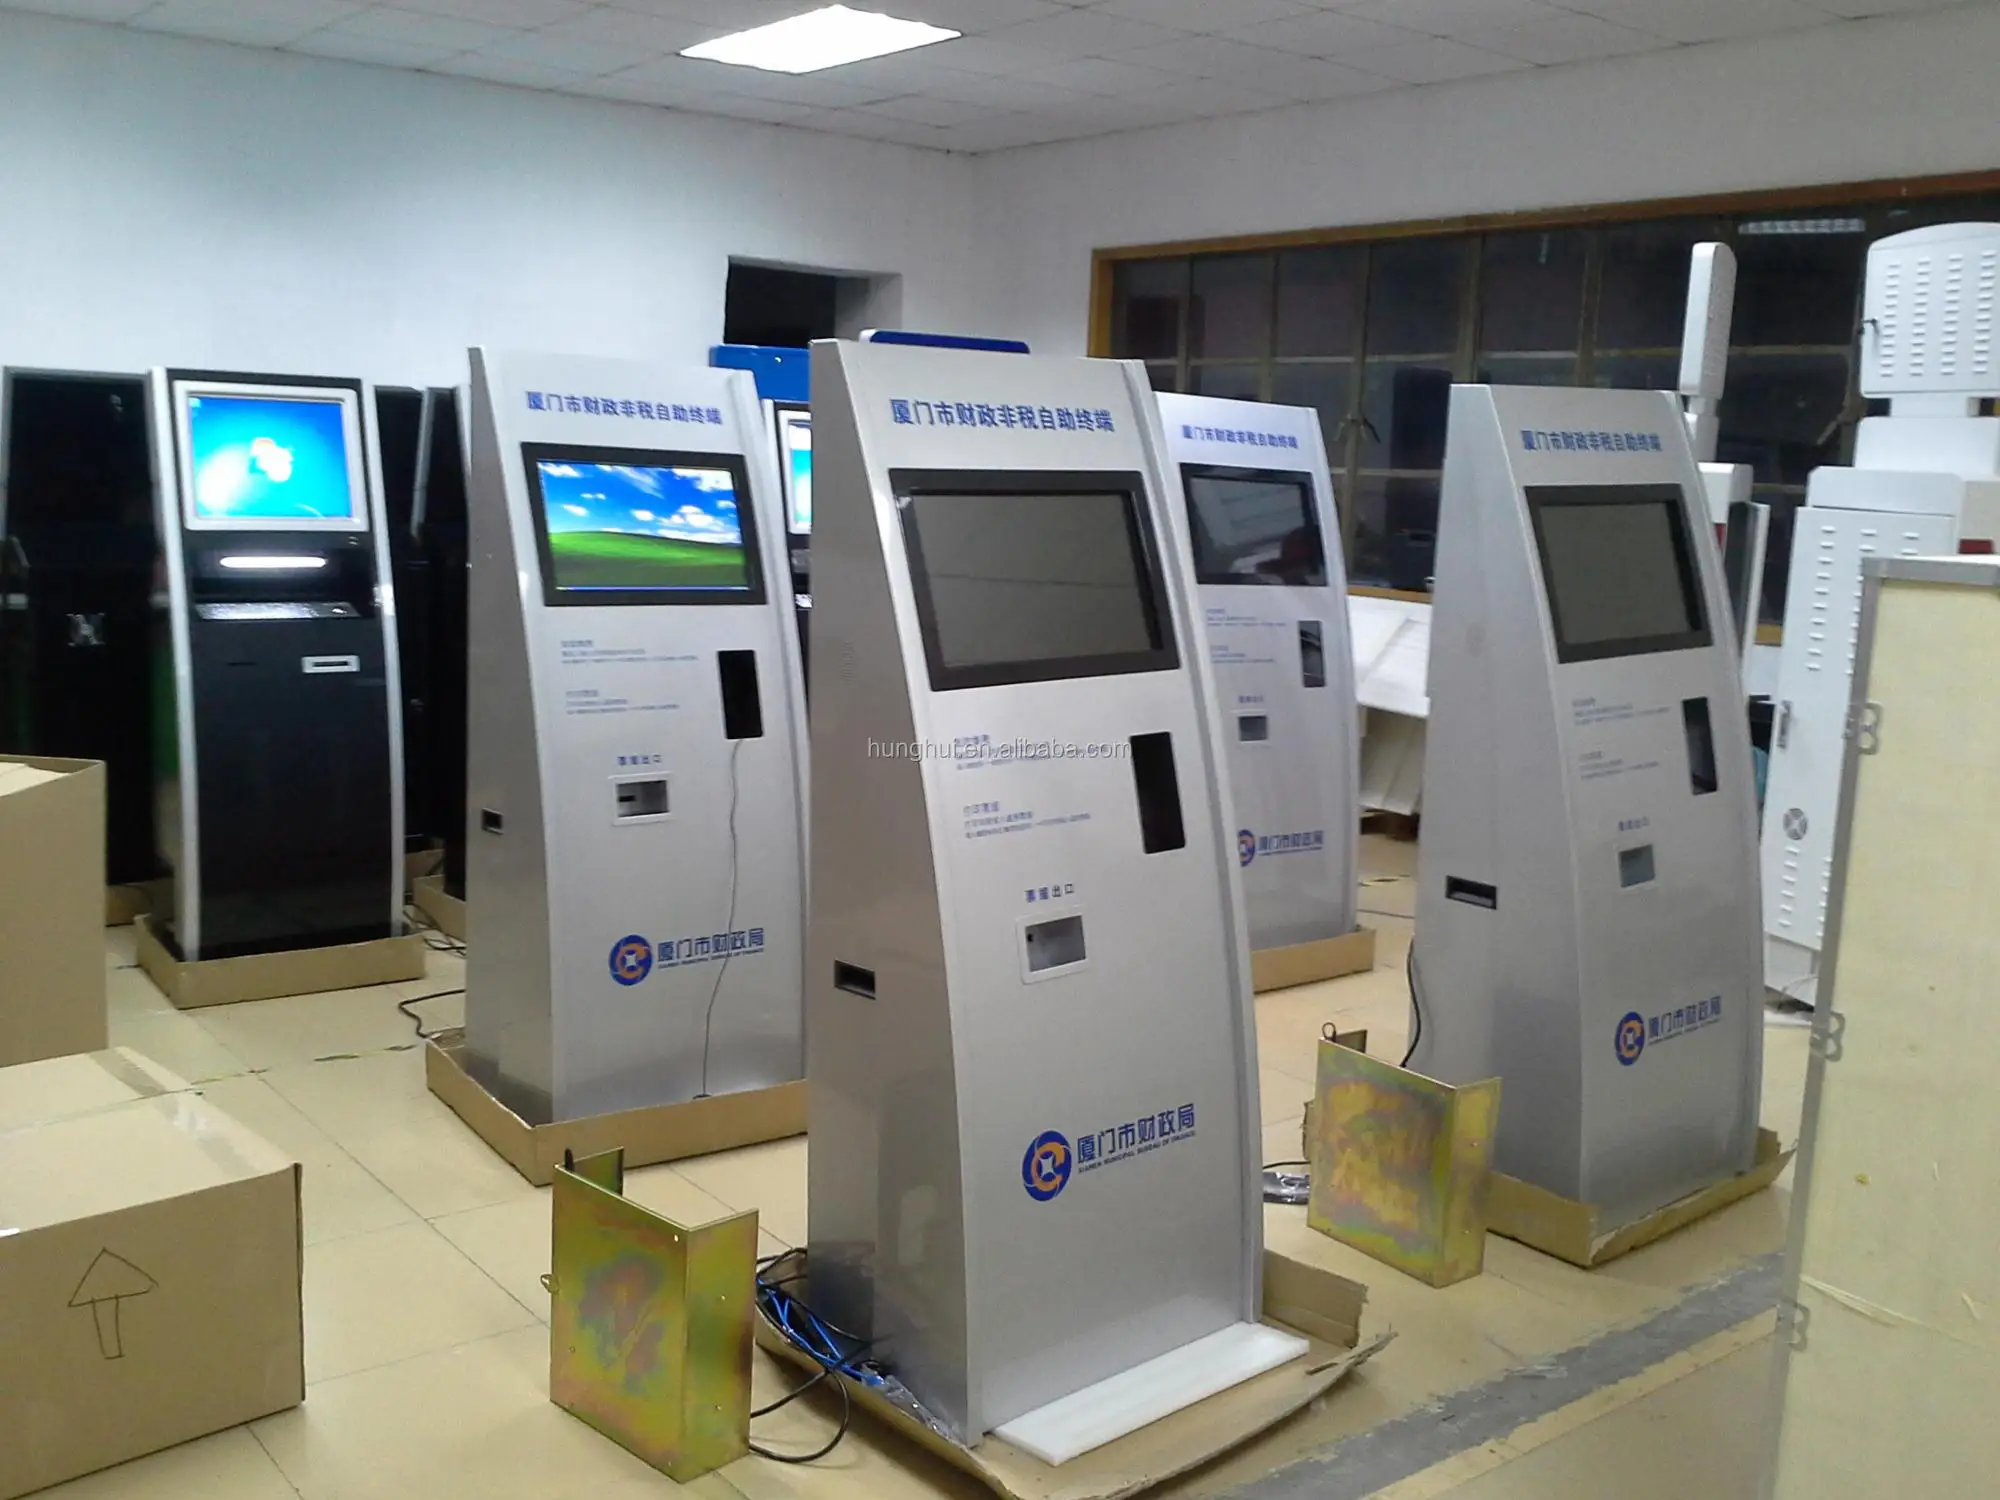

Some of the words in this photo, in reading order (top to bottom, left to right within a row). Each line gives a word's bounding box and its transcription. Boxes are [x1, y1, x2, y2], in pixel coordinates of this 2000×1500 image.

[526, 391, 723, 425] 厦门市财政非税自助终端
[890, 399, 1115, 433] 厦门市财政非税自助终端
[1076, 1103, 1196, 1164] 厦门市财政局
